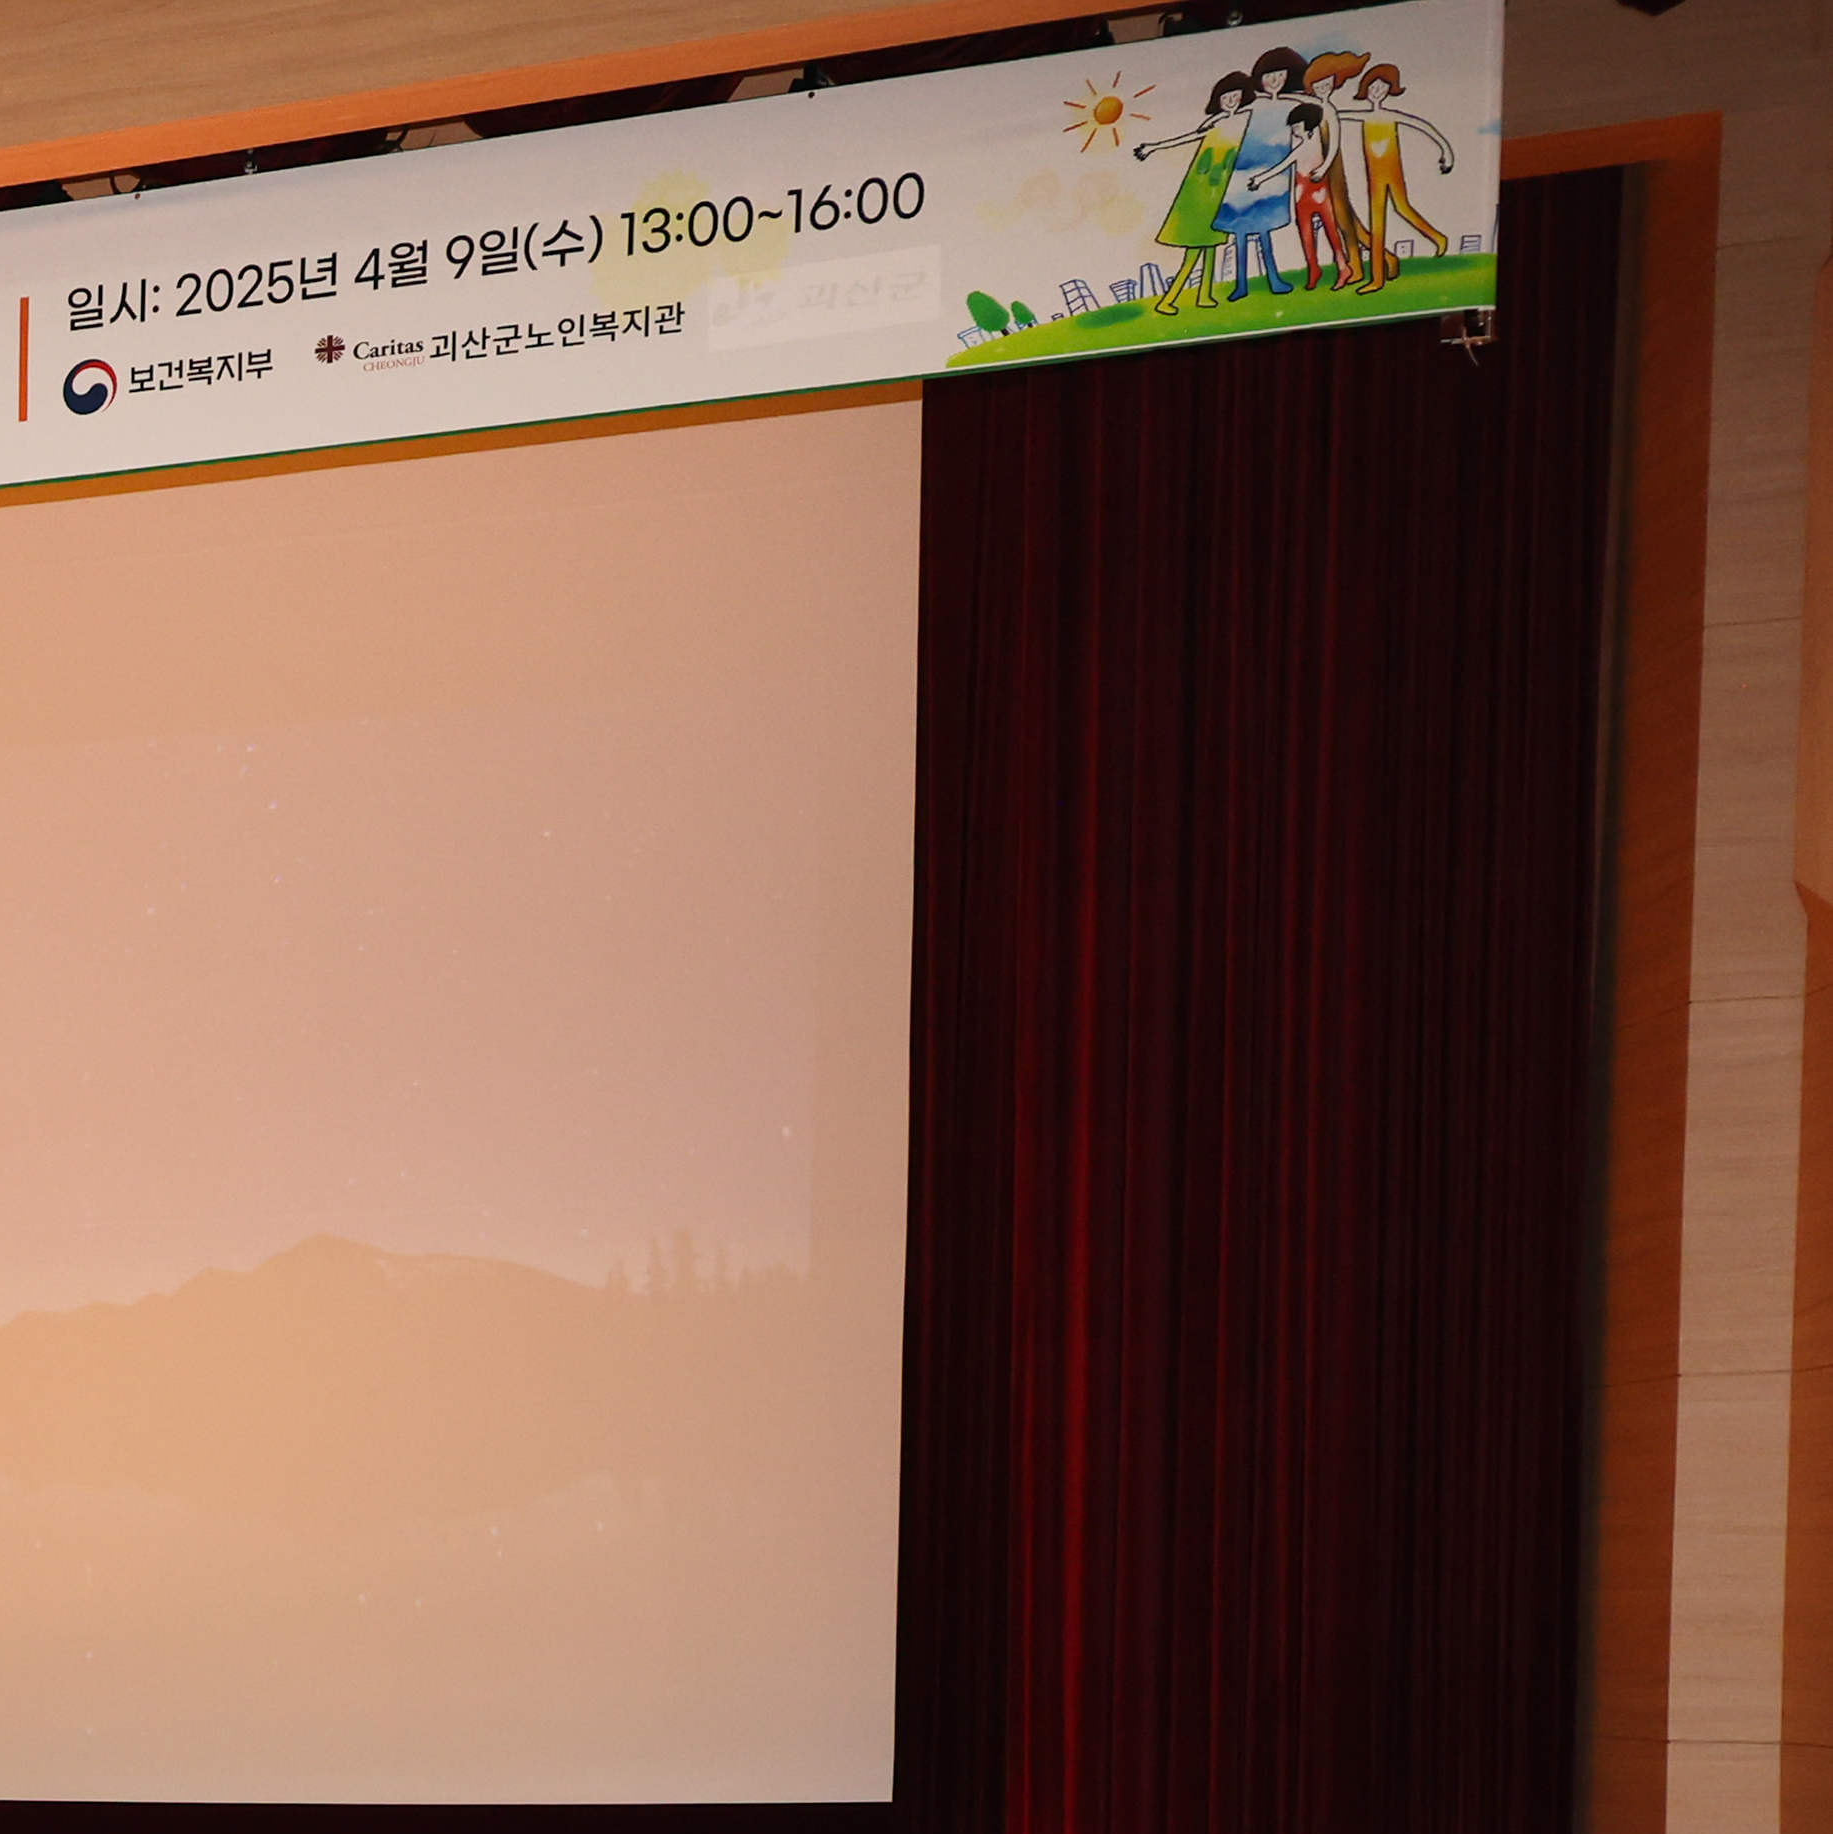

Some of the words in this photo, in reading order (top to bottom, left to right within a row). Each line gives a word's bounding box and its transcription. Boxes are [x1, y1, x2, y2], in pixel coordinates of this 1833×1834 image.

[67, 278, 160, 332] 일시:
[175, 251, 337, 317] 2025년
[354, 239, 428, 291] 4월
[445, 214, 603, 280] 9일(수)
[620, 172, 925, 257] 13:00~16:00
[352, 337, 426, 362] Caritas
[429, 301, 686, 362] 괴산군노인복지관
[128, 348, 274, 394] 보건복지부
[362, 354, 426, 373] CHEONGJU
